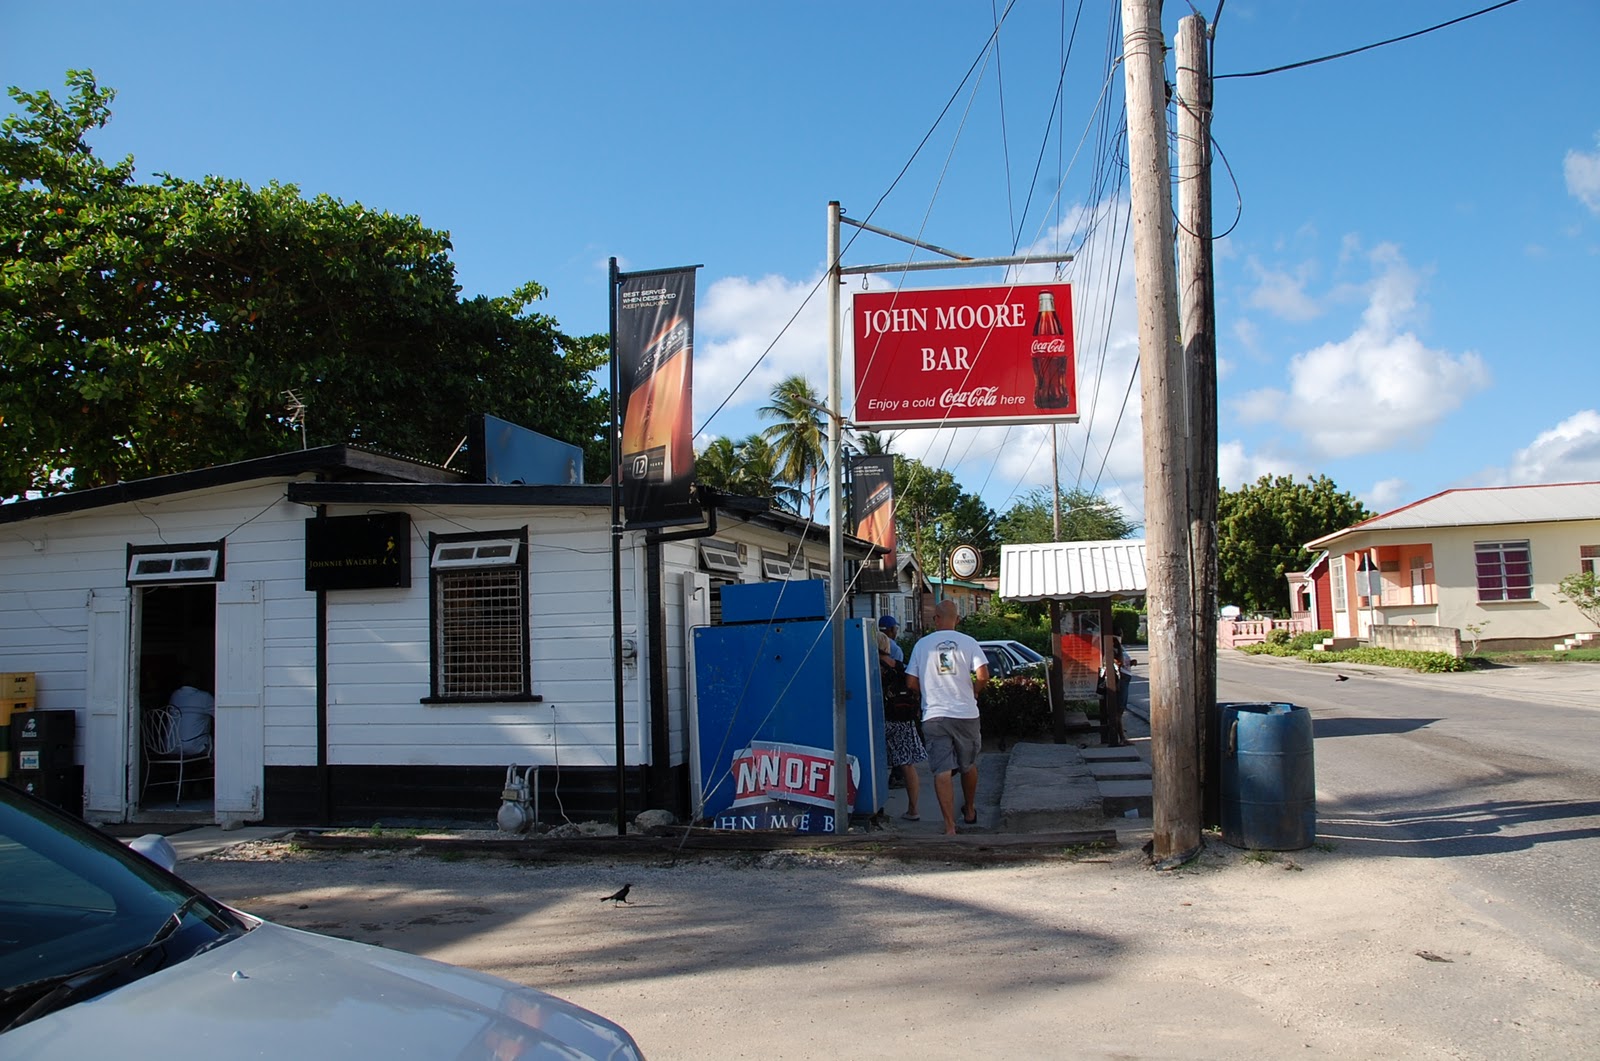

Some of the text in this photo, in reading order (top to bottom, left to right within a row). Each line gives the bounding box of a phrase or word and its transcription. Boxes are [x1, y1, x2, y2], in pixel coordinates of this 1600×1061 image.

[641, 288, 667, 296] SERVED
[642, 293, 676, 302] DESERVED
[863, 303, 1026, 339] JOHN MOORE
[1030, 338, 1066, 354] Coca-Cola
[920, 346, 970, 372] BAR
[868, 386, 1026, 411] Enjoy a cold Coca-Cola here
[635, 459, 645, 474] 12
[308, 558, 378, 570] JOHNNIE WALKER
[713, 815, 757, 830] HN
